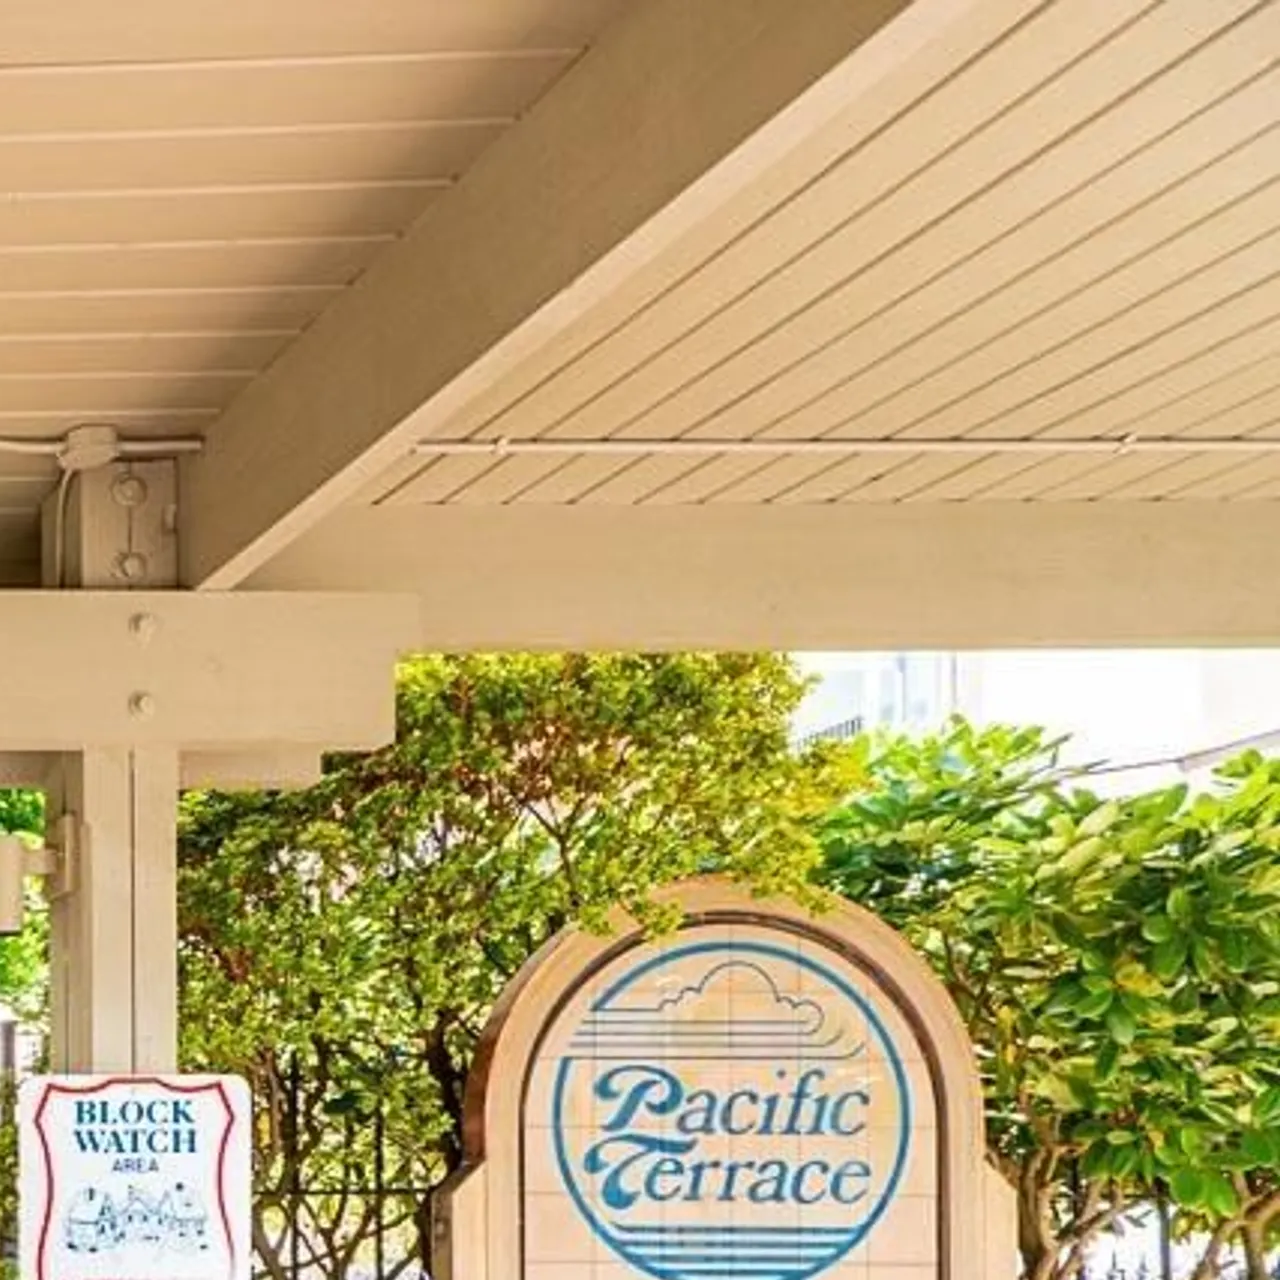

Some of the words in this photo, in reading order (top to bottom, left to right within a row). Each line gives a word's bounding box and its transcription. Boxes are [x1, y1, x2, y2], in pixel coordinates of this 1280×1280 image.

[74, 1100, 196, 1125] BLOCK
[593, 1064, 870, 1136] Pacific
[73, 1128, 197, 1154] WATCH
[111, 1158, 160, 1172] AREA
[583, 1133, 872, 1210] Terrace
